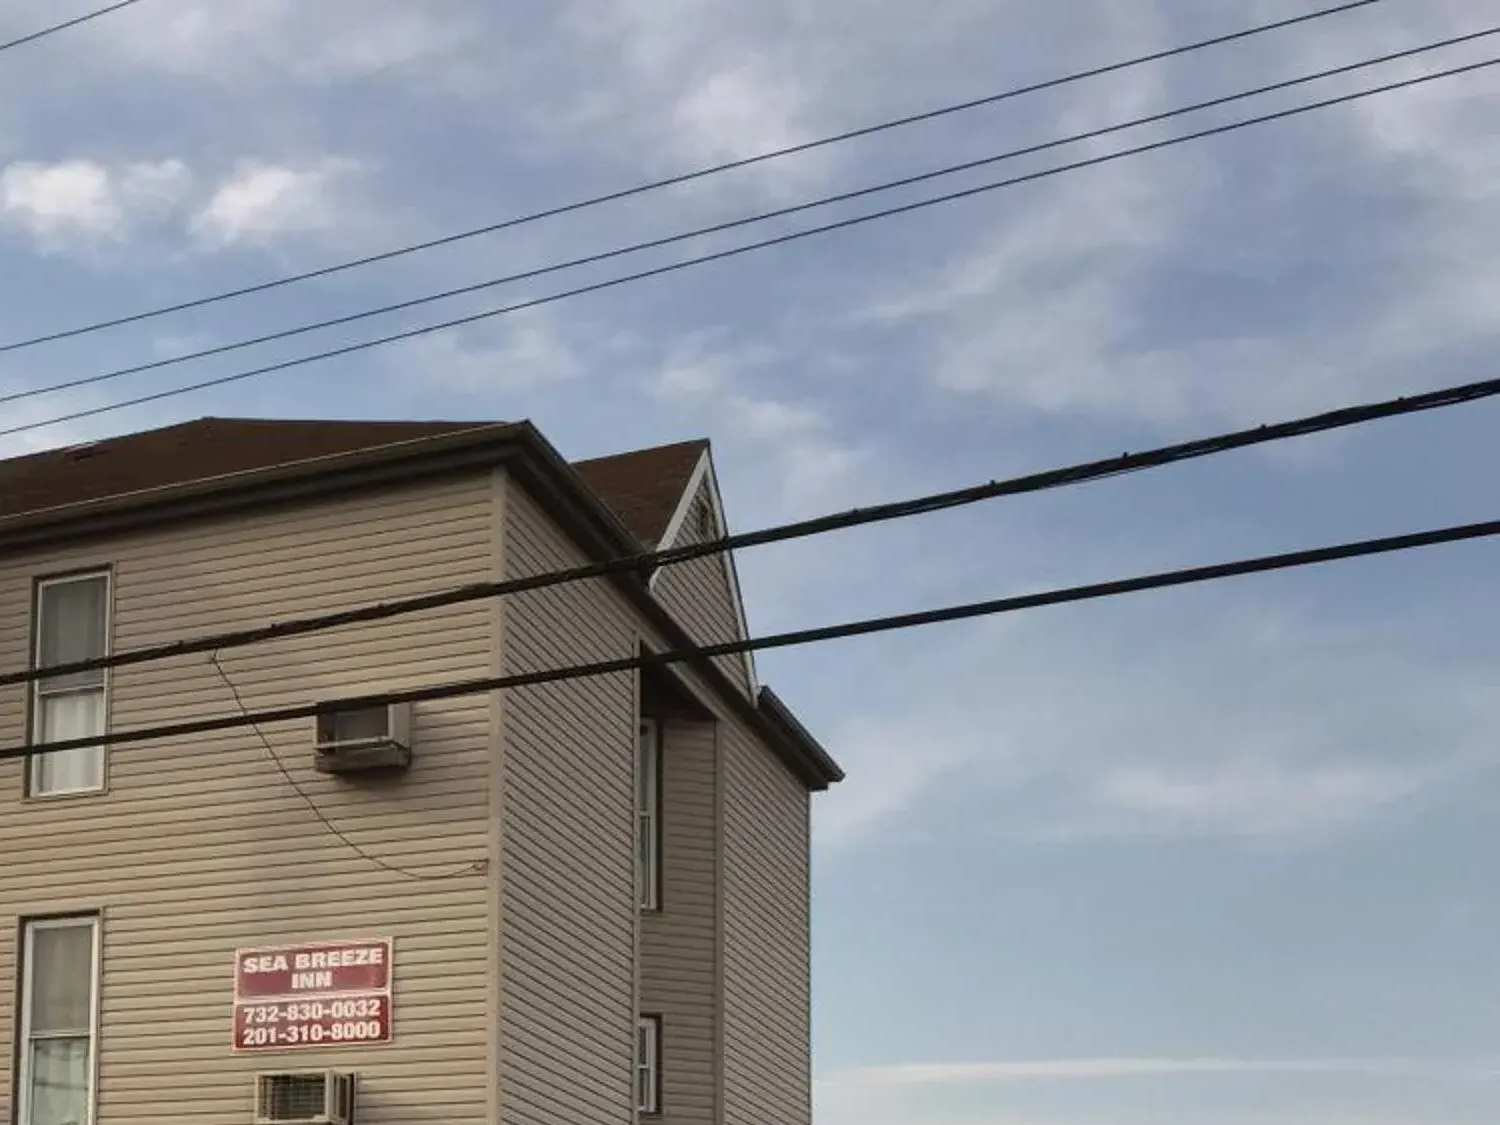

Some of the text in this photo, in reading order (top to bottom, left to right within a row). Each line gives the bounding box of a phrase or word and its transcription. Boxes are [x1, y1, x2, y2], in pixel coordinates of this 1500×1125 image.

[243, 948, 383, 974] SEA BREEZE
[291, 970, 333, 989] INN
[243, 999, 381, 1025] 732-830-0032
[243, 1021, 381, 1046] 201-310-8000
